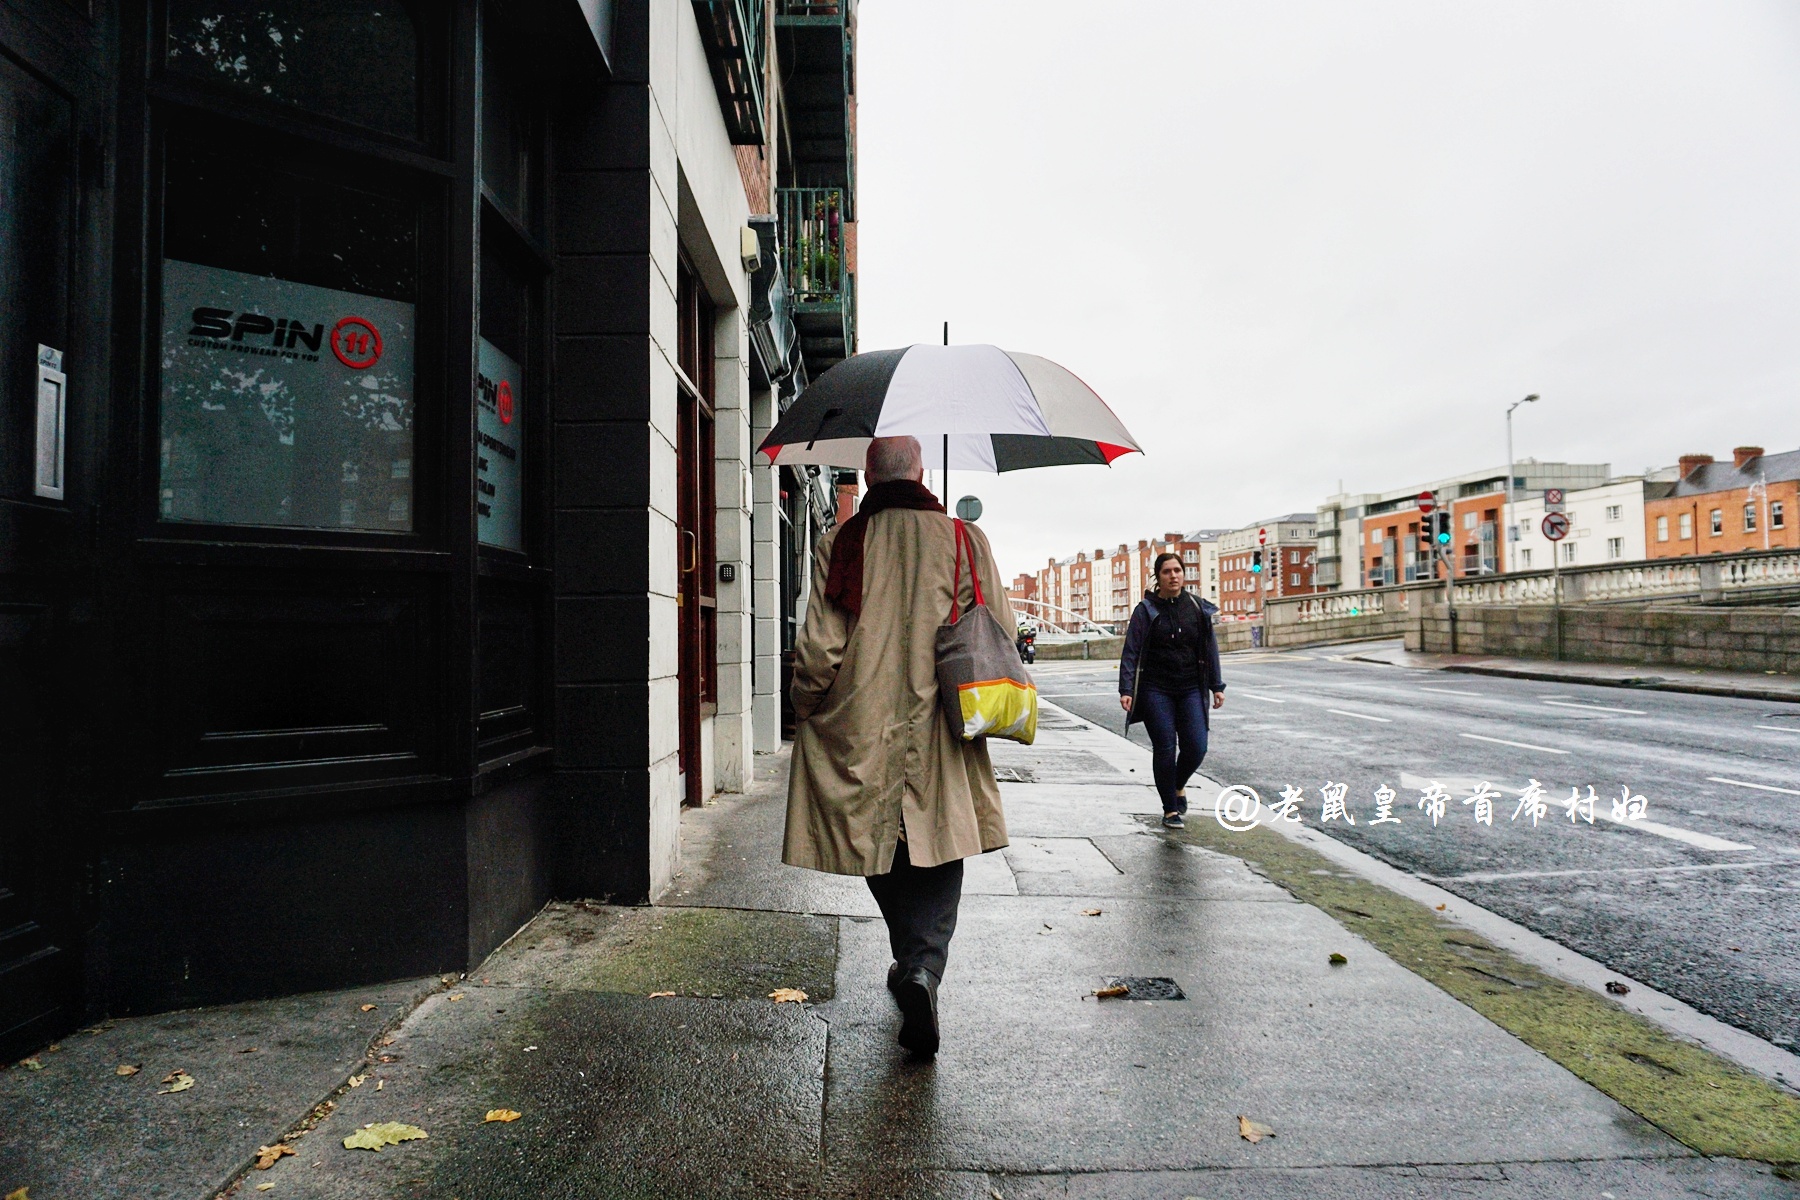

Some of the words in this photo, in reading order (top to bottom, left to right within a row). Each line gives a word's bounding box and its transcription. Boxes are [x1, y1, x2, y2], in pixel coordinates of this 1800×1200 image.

[188, 338, 228, 351] CUSTOM
[230, 345, 278, 357] PROWEAR
[281, 351, 298, 360] FOR
[302, 353, 320, 363] YOU
[344, 331, 369, 355] 11
[478, 372, 498, 407] PIN
